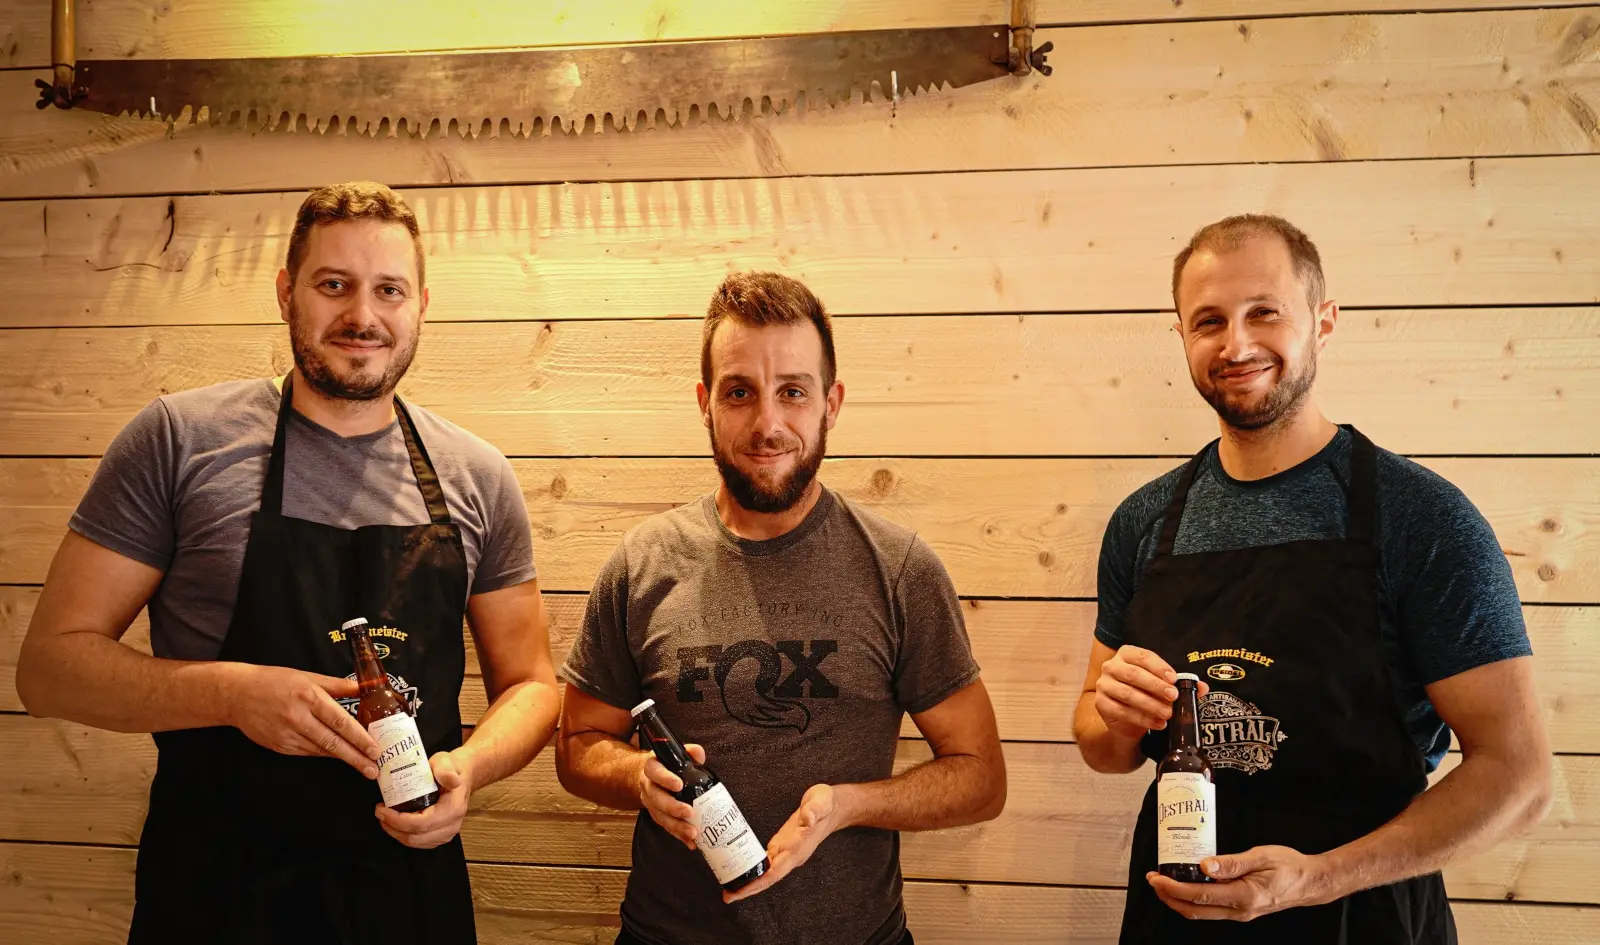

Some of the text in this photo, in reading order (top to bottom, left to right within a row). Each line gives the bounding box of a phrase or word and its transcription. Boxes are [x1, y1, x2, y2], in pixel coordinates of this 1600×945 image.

[328, 625, 408, 644] Brmeister
[676, 640, 840, 703] FOX
[1187, 648, 1275, 667] Braumeister
[1201, 718, 1271, 746] STRAL
[703, 804, 739, 846] DESTRA
